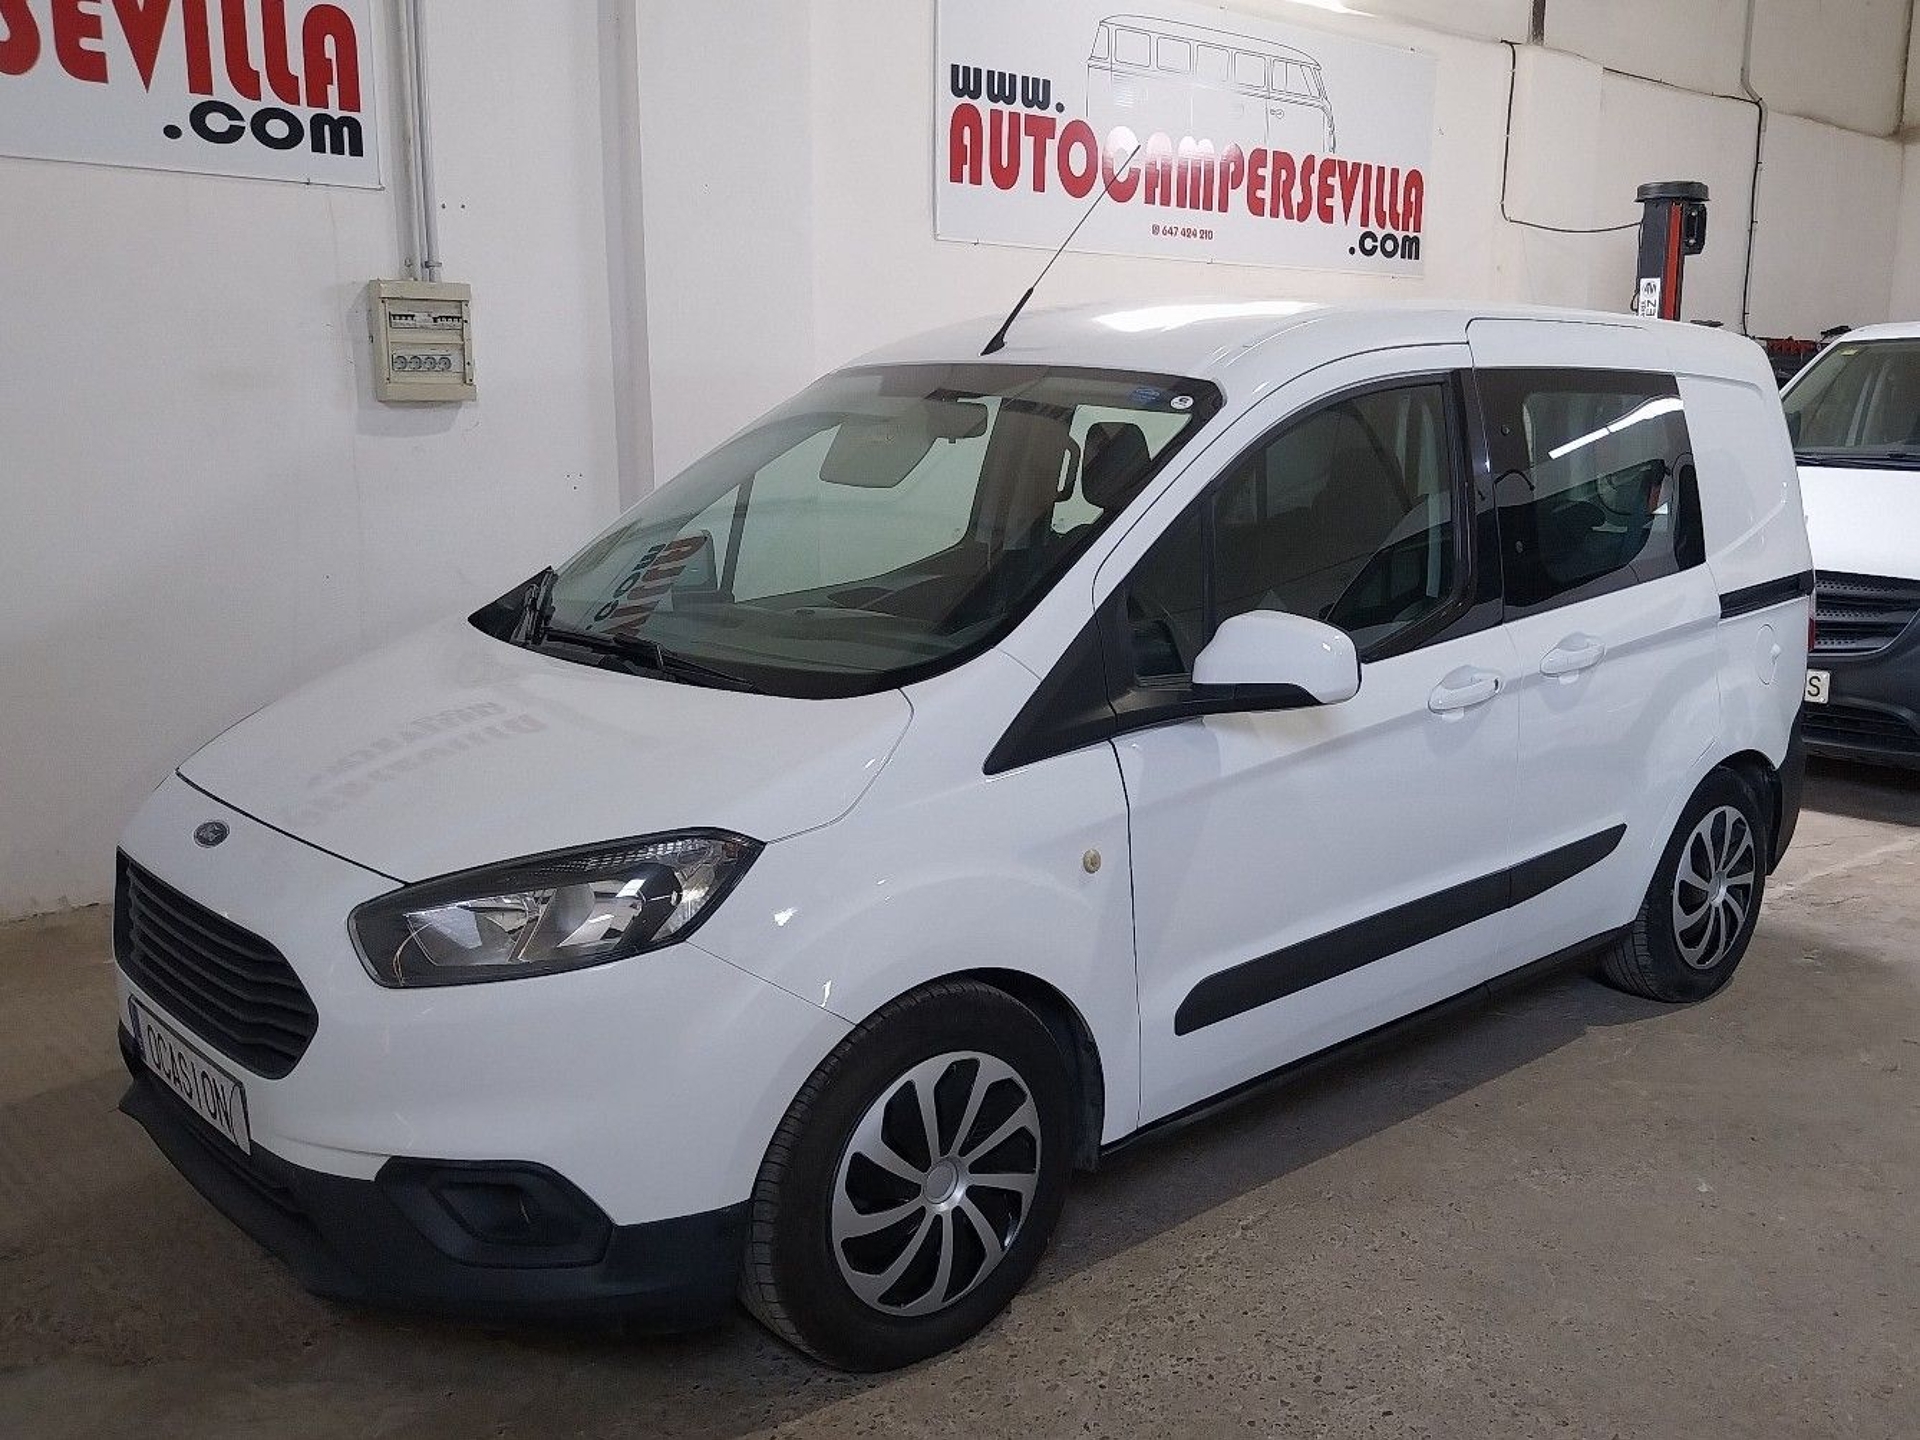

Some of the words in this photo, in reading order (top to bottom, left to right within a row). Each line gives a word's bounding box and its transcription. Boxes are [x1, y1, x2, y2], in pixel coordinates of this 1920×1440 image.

[163, 100, 364, 157] .com
[949, 103, 1425, 233] AUTOCAMPERSEVILLA
[1162, 225, 1178, 237] 647
[1180, 227, 1198, 238] 424
[1199, 229, 1214, 240] 210
[1347, 230, 1421, 261] .com
[1807, 675, 1822, 697] S
[147, 1024, 233, 1134] OCASION
